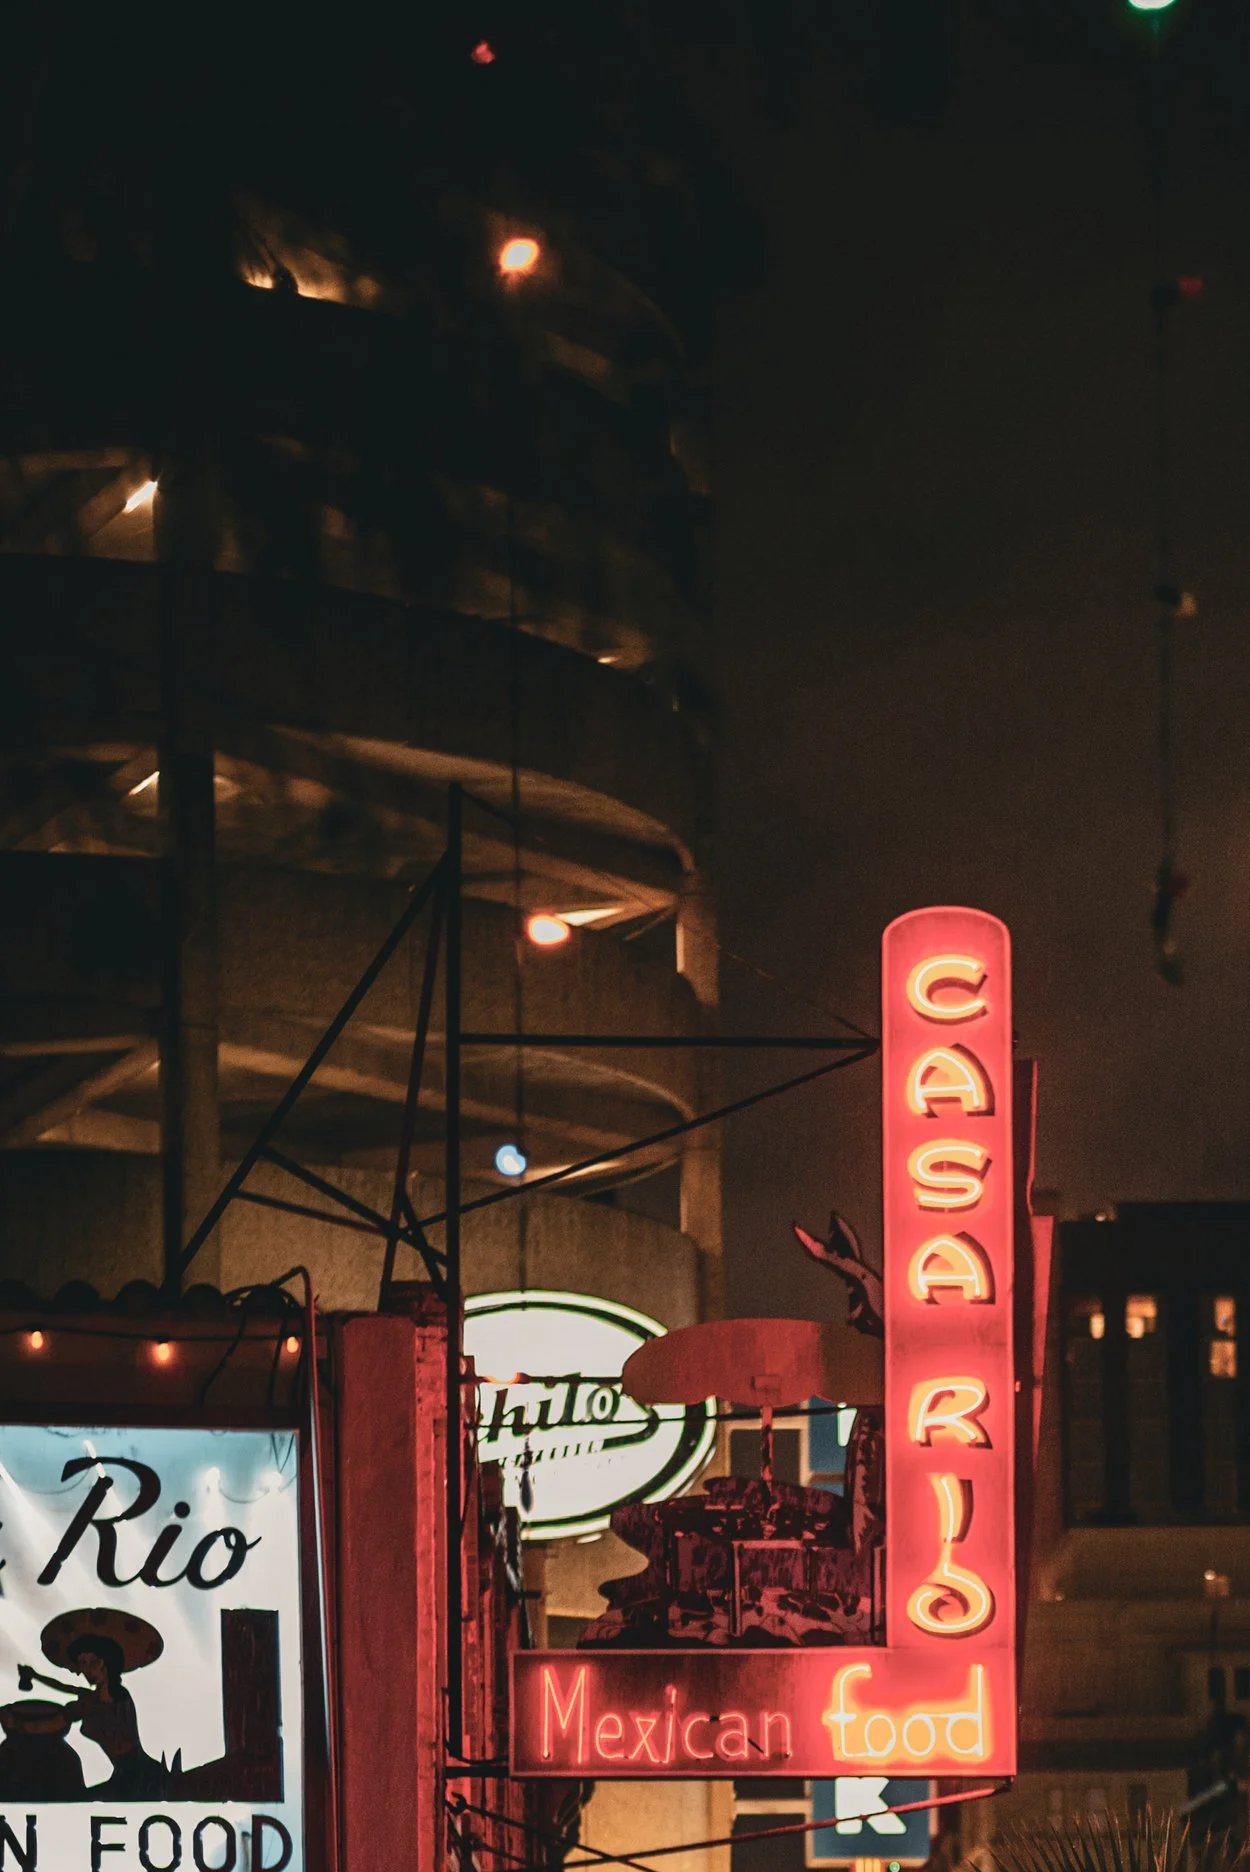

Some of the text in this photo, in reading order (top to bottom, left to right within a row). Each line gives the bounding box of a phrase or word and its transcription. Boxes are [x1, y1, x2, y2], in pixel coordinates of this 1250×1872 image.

[906, 953, 998, 1306] CASA
[36, 1456, 263, 1589] Rio
[906, 1376, 995, 1637] RIO
[541, 1662, 986, 1764] Mexican food
